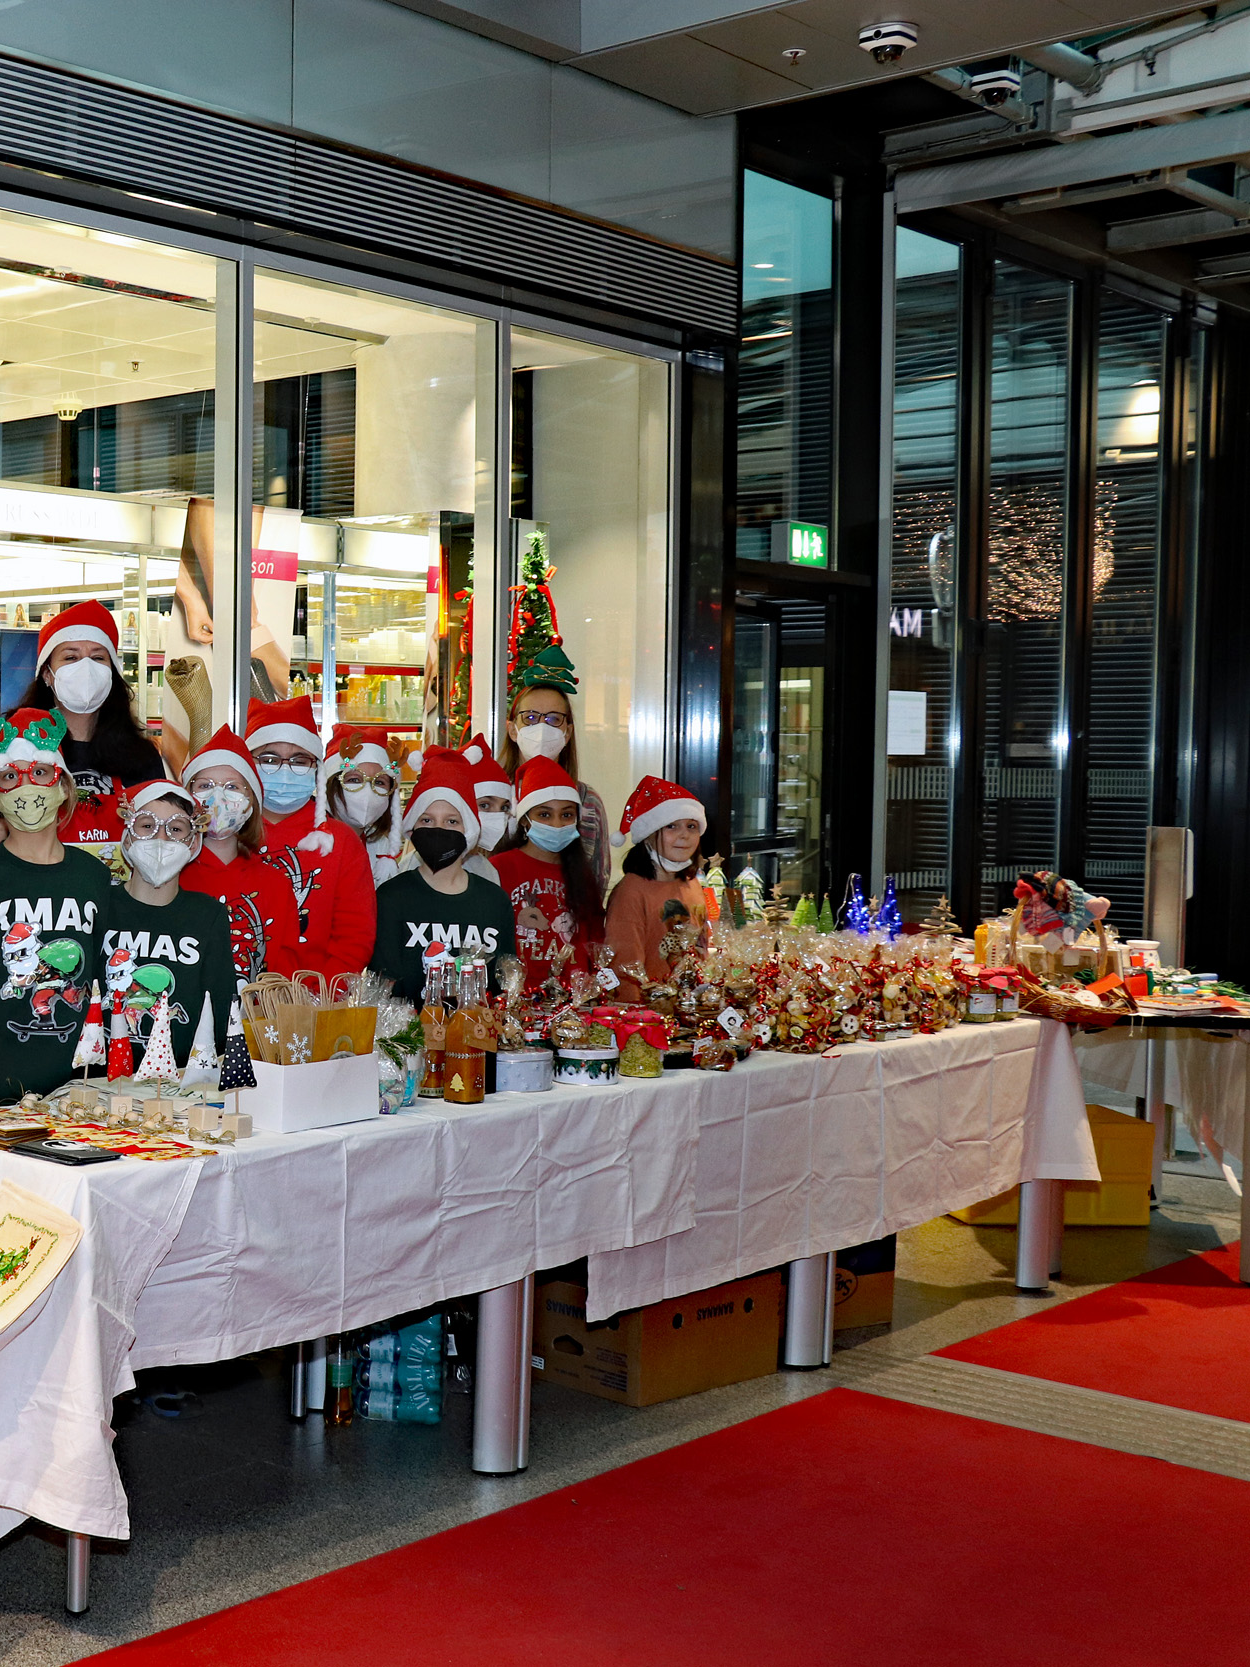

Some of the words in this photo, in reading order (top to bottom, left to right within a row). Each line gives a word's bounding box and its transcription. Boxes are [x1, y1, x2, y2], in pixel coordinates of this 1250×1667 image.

[78, 828, 110, 842] KARIN
[511, 878, 567, 906] SPARK
[404, 921, 500, 954] XMAS
[517, 938, 577, 965] TEA
[546, 1300, 587, 1321] ANANAS
[696, 1300, 735, 1322] BANANAS
[406, 1333, 433, 1411] VÖSLAUER
